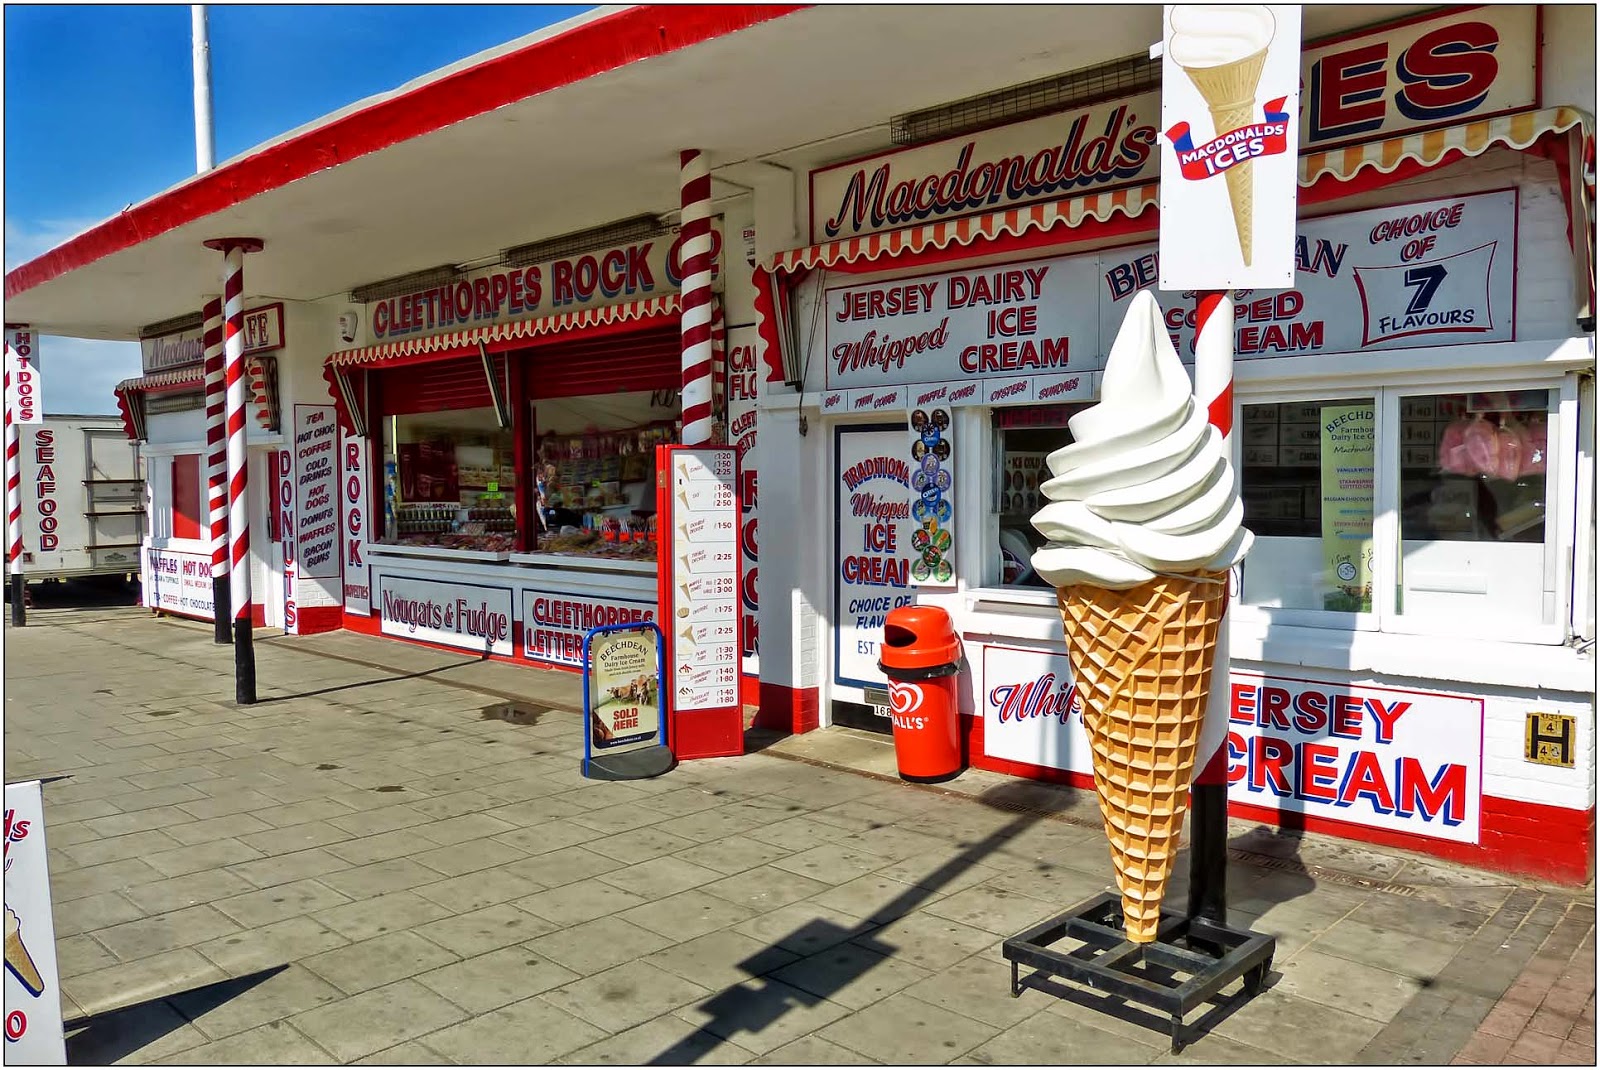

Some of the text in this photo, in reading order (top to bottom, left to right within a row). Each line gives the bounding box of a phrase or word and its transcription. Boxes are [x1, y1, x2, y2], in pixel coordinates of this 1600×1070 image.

[1182, 124, 1284, 164] MACDONALDS
[1205, 138, 1264, 176] ICES
[825, 105, 1160, 238] Macdonald's
[1371, 203, 1465, 244] CHOICE
[1401, 235, 1436, 262] OF
[373, 265, 541, 338] CLEETHORPES
[551, 242, 655, 306] ROCK
[836, 266, 1050, 323] JERSEY DAIRY
[1404, 264, 1448, 315] 7
[987, 305, 1037, 339] ICE
[1379, 309, 1475, 334] FLAVOURS
[833, 317, 949, 375] Whipped
[959, 337, 1069, 375] CREAM
[16, 333, 33, 421] HOT DOGS
[917, 384, 976, 406] WAFFLE CONES
[990, 380, 1028, 402] OYSTERS
[1038, 377, 1079, 400] SUNDAES
[854, 392, 897, 409] TWIN CONES
[306, 412, 324, 425] TEA
[1326, 411, 1374, 433] BEECHD
[297, 424, 335, 444] HOT CHOC
[299, 440, 331, 459] COFFEE
[306, 457, 328, 472] COLD
[842, 457, 910, 493] TRADITIONA
[300, 467, 332, 485] DRINKS
[36, 430, 59, 551] SEAFOOD
[305, 493, 329, 510] DOGS
[308, 484, 326, 498] HOT
[346, 443, 362, 567] ROCK
[300, 508, 333, 528] DONUTS
[280, 450, 297, 627] DONUTS
[299, 523, 336, 543] WAFFLES
[864, 523, 897, 553] ICE
[303, 539, 333, 558] BACON
[307, 551, 330, 568] BUNS
[182, 560, 197, 576] HOT
[198, 562, 213, 578] DOG
[849, 595, 912, 614] CHOICE OF
[383, 589, 508, 646] Nougats & Fudge
[600, 641, 648, 661] BEECHDEAN
[611, 653, 638, 661] Farmhouse
[857, 640, 876, 655] EST.
[605, 660, 618, 668] Dairy
[629, 657, 645, 665] Cream
[613, 707, 638, 720] SOLD
[613, 718, 638, 731] HERE
[1229, 683, 1412, 744] ERSEY
[1546, 722, 1555, 733] 4
